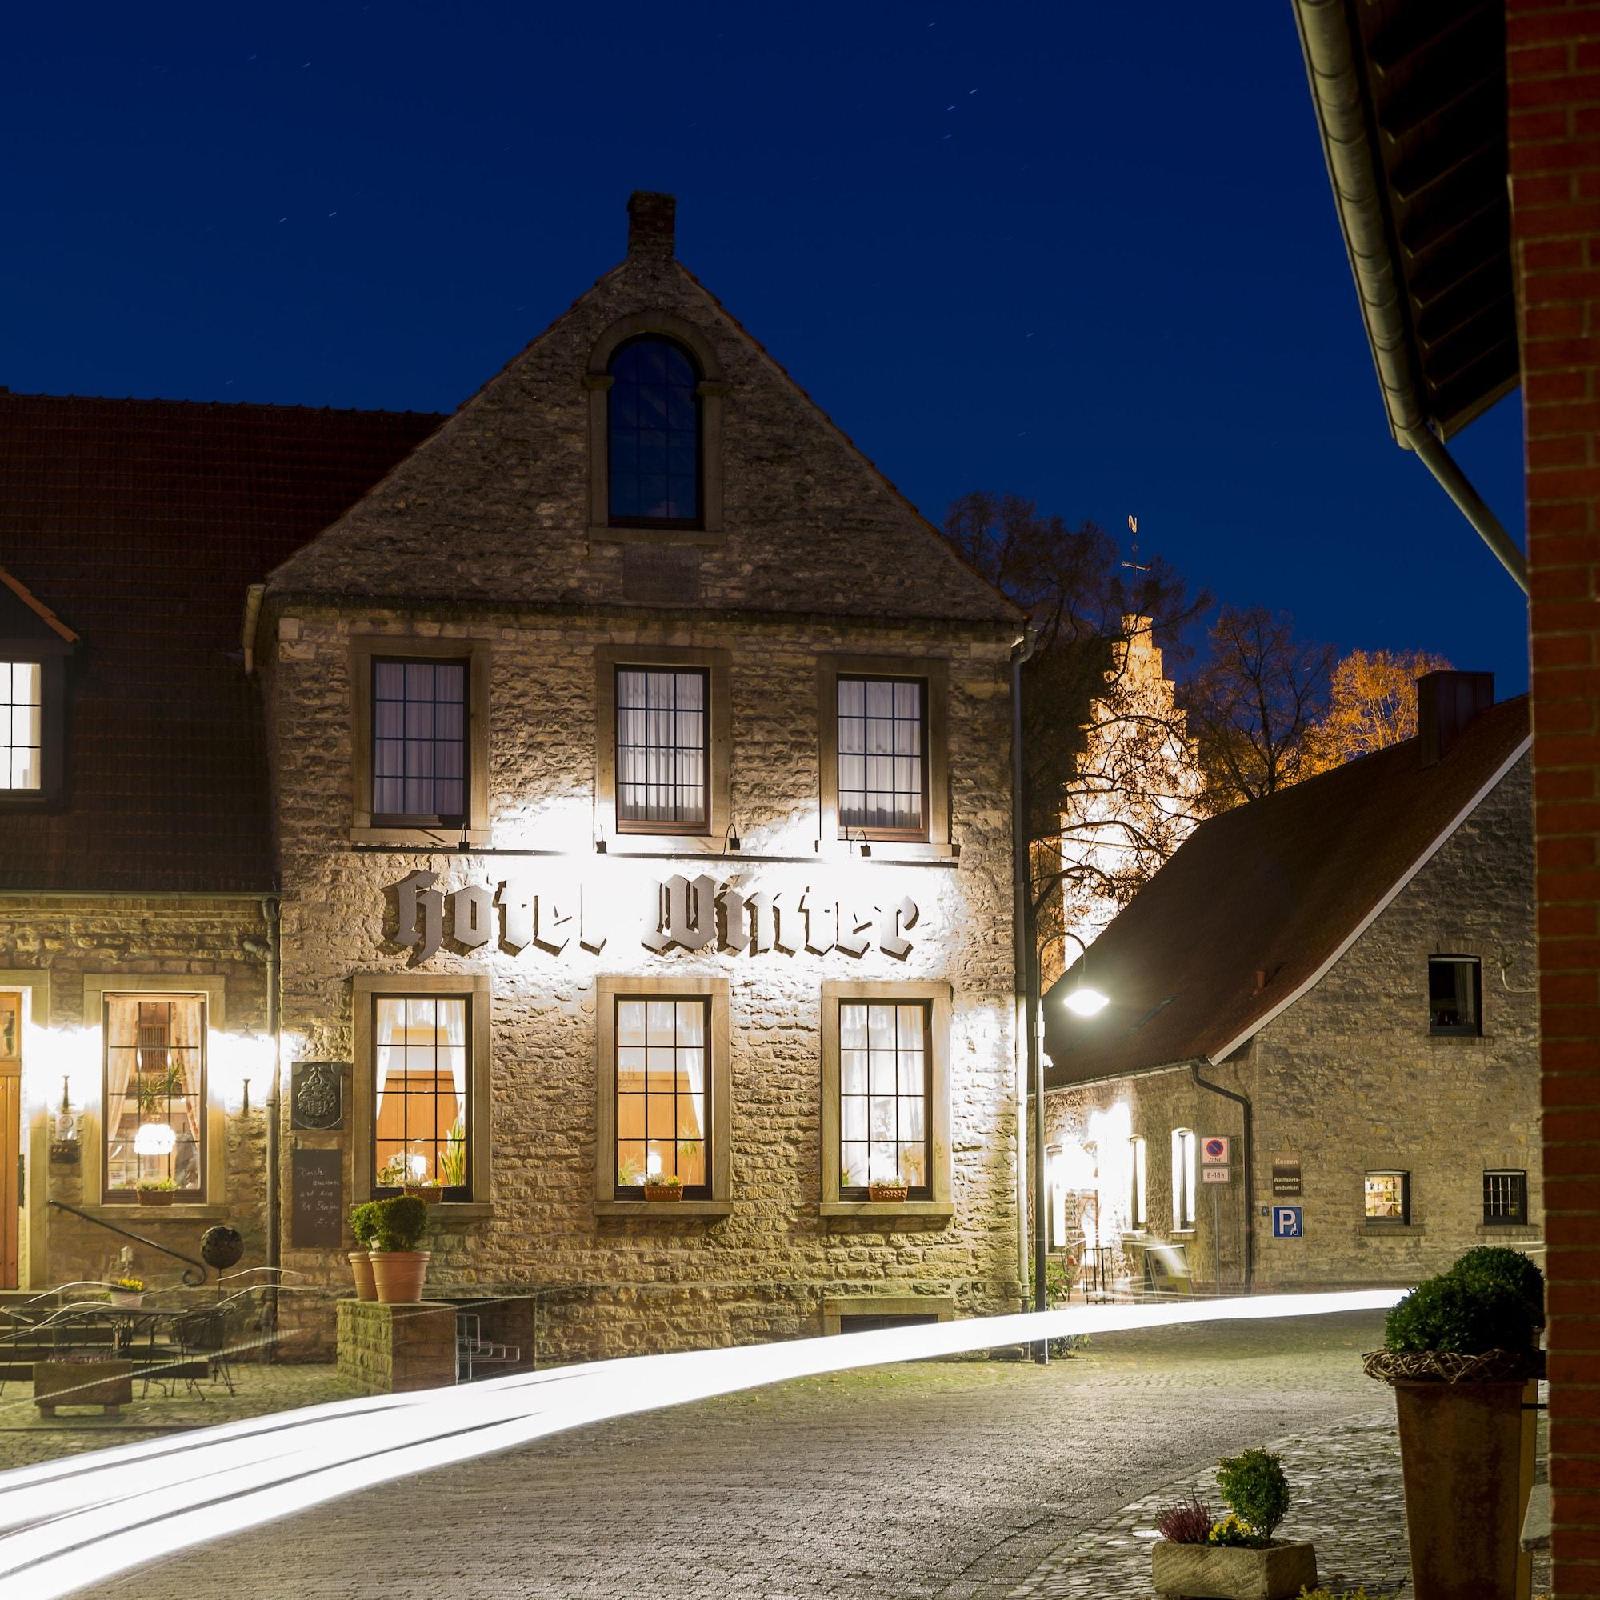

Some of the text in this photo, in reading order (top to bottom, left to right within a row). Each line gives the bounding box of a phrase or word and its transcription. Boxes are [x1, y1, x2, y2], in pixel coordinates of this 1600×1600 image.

[386, 868, 919, 970] Hotel Winter
[1279, 1209, 1296, 1234] P
